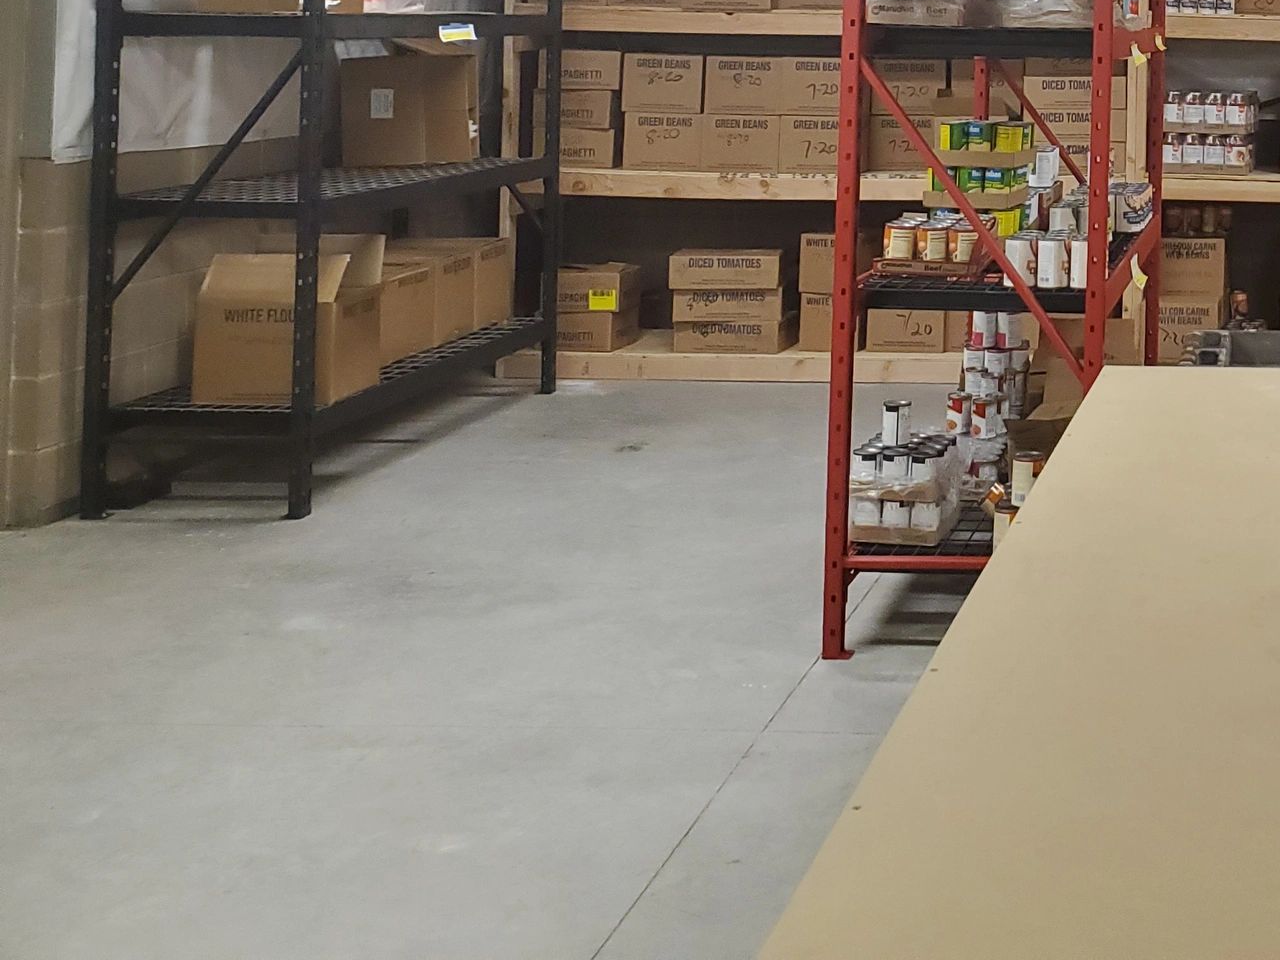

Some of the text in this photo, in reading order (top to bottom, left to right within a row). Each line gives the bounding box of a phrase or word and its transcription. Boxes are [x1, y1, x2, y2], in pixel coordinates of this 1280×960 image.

[637, 58, 691, 69] GREEN BEANS
[718, 60, 771, 72] GREEN BEANS
[795, 60, 820, 71] GREEN
[884, 62, 935, 73] GREEN BEANS
[1042, 79, 1066, 91] DICED
[806, 83, 839, 100] 7-20
[638, 116, 692, 128] GREEN BEANS
[1040, 112, 1064, 123] DICED
[715, 118, 769, 130] GREEN BEANS
[793, 119, 819, 130] GREEN
[800, 140, 837, 159] 7-20
[806, 238, 829, 248] WHITE
[1194, 243, 1216, 252] CARNE
[688, 257, 762, 269] DICED TOMATOES
[720, 291, 766, 303] TOMATOES
[806, 295, 830, 306] WHITE
[224, 308, 264, 324] WHITE
[1186, 307, 1210, 317] CARNE
[1178, 316, 1202, 326] BEANS
